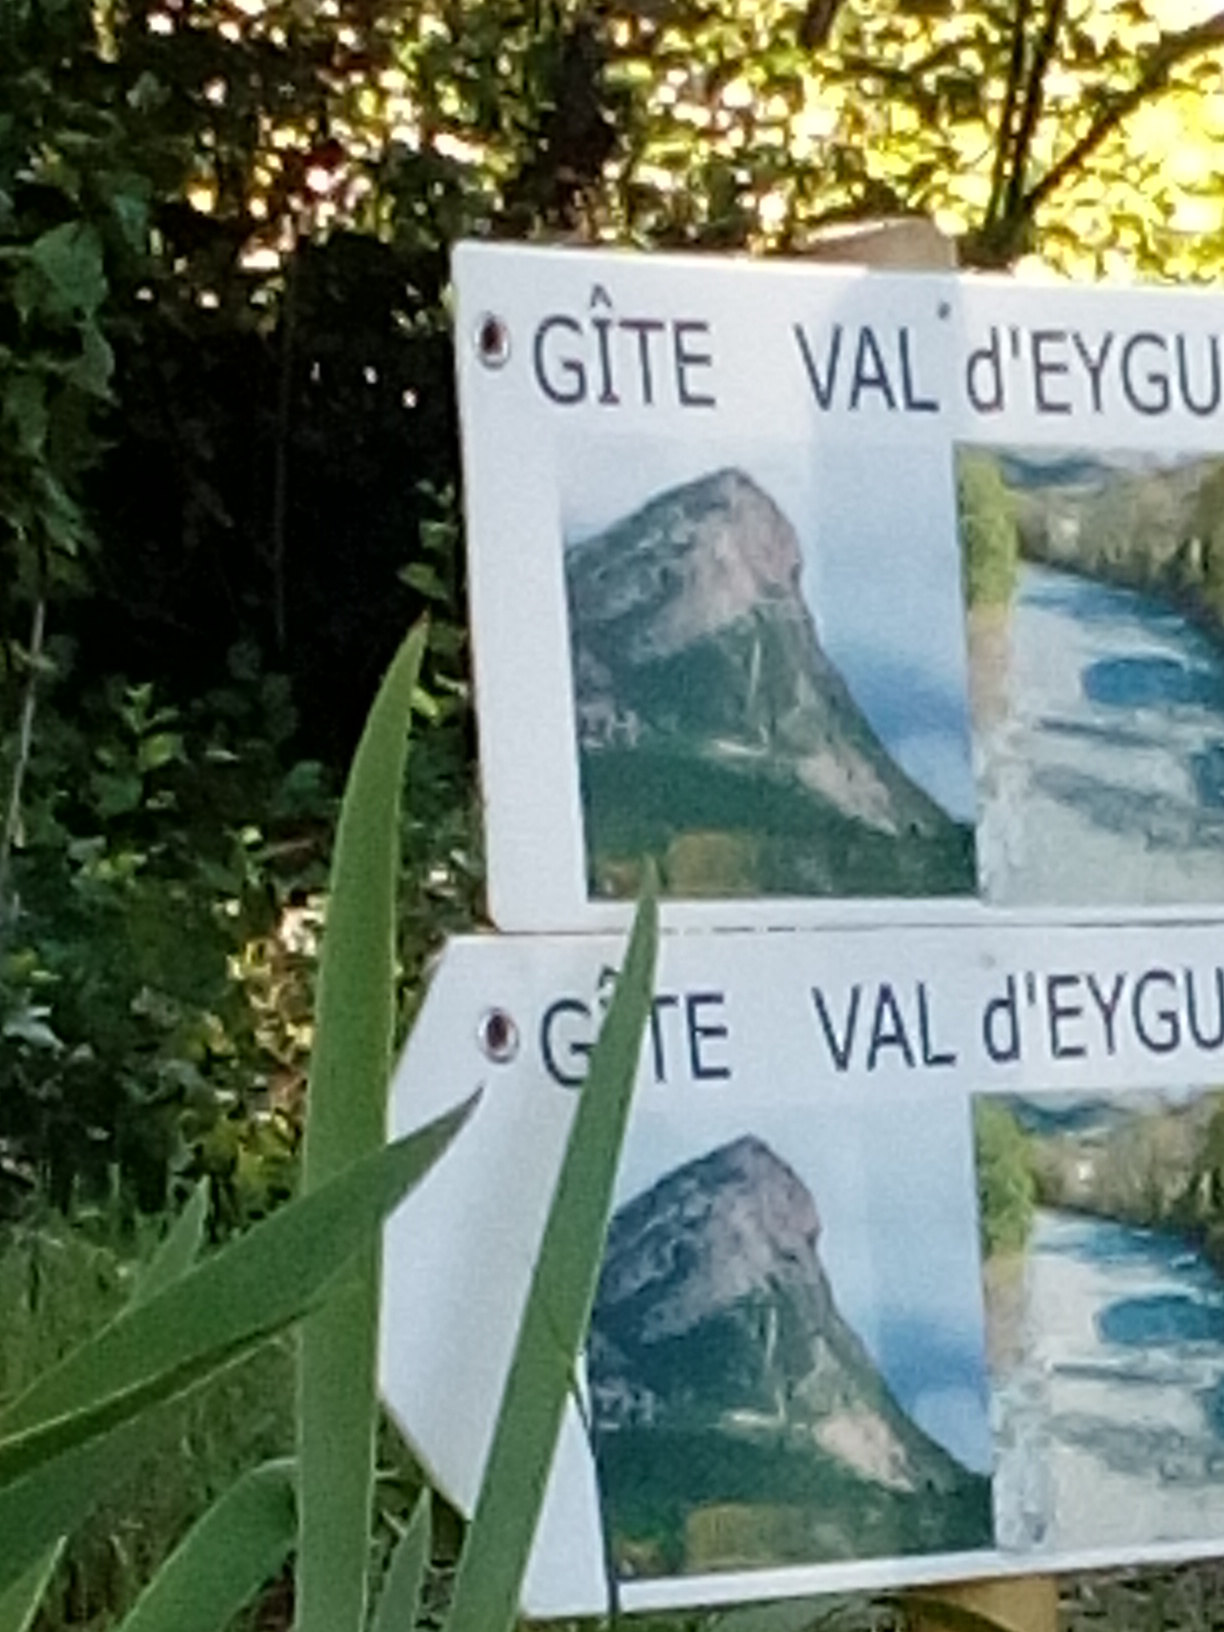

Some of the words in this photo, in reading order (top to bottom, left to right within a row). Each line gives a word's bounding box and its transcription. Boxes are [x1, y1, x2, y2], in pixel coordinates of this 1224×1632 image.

[533, 284, 717, 408] GÎTE
[795, 324, 940, 412] VAL
[811, 980, 956, 1072] VAL
